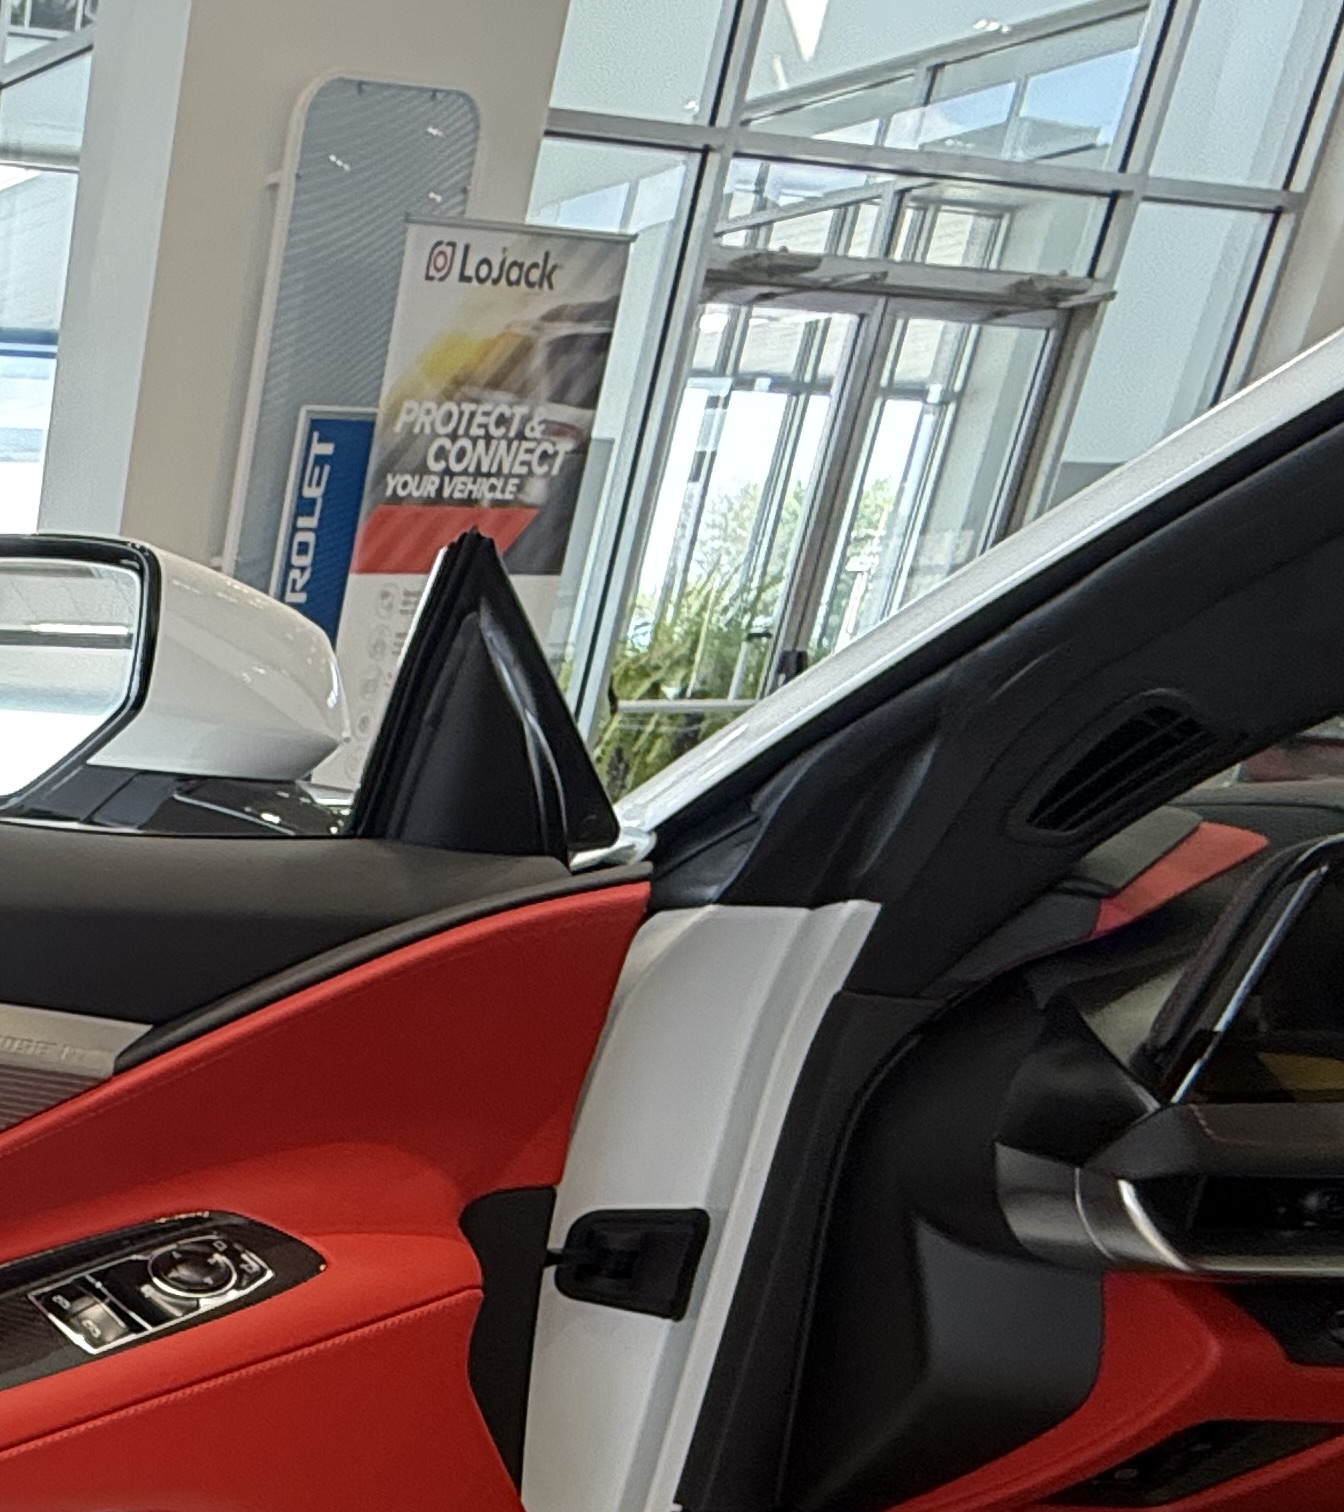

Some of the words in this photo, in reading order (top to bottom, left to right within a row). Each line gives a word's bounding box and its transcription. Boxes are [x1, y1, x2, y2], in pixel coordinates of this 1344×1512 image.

[393, 401, 529, 438] PROTECT
[524, 411, 545, 439] &
[427, 437, 574, 475] CONNECT
[385, 472, 441, 498] YOUR
[442, 474, 520, 500] VEHICLE
[285, 431, 335, 603] ROLET
